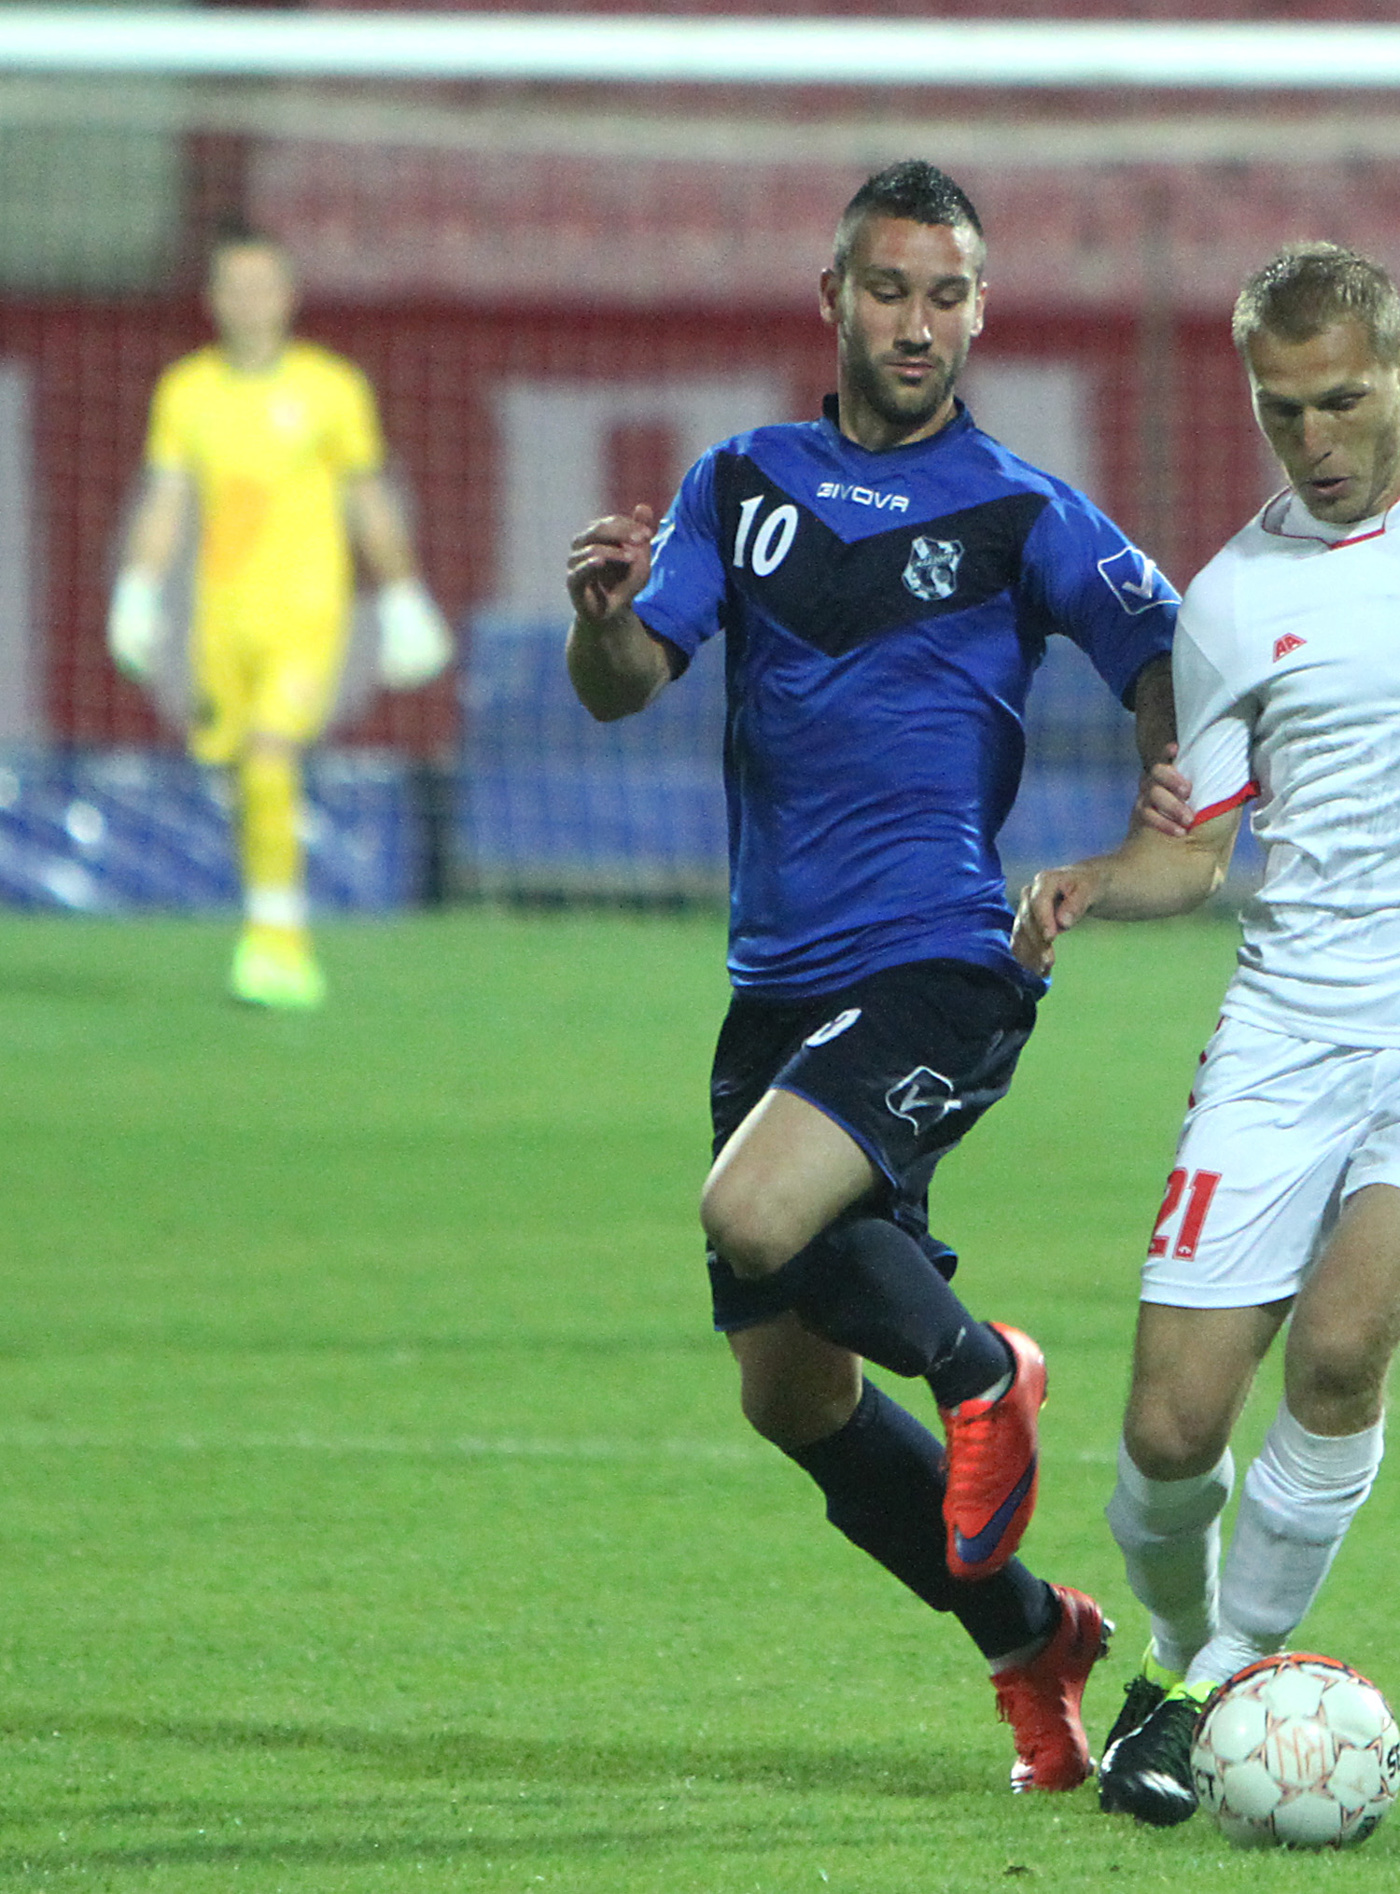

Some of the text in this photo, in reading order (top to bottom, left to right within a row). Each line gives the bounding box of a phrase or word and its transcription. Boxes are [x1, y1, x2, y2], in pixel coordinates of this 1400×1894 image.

[732, 494, 799, 577] 10
[816, 482, 910, 512] GIVOVA
[1147, 1166, 1223, 1262] 21
